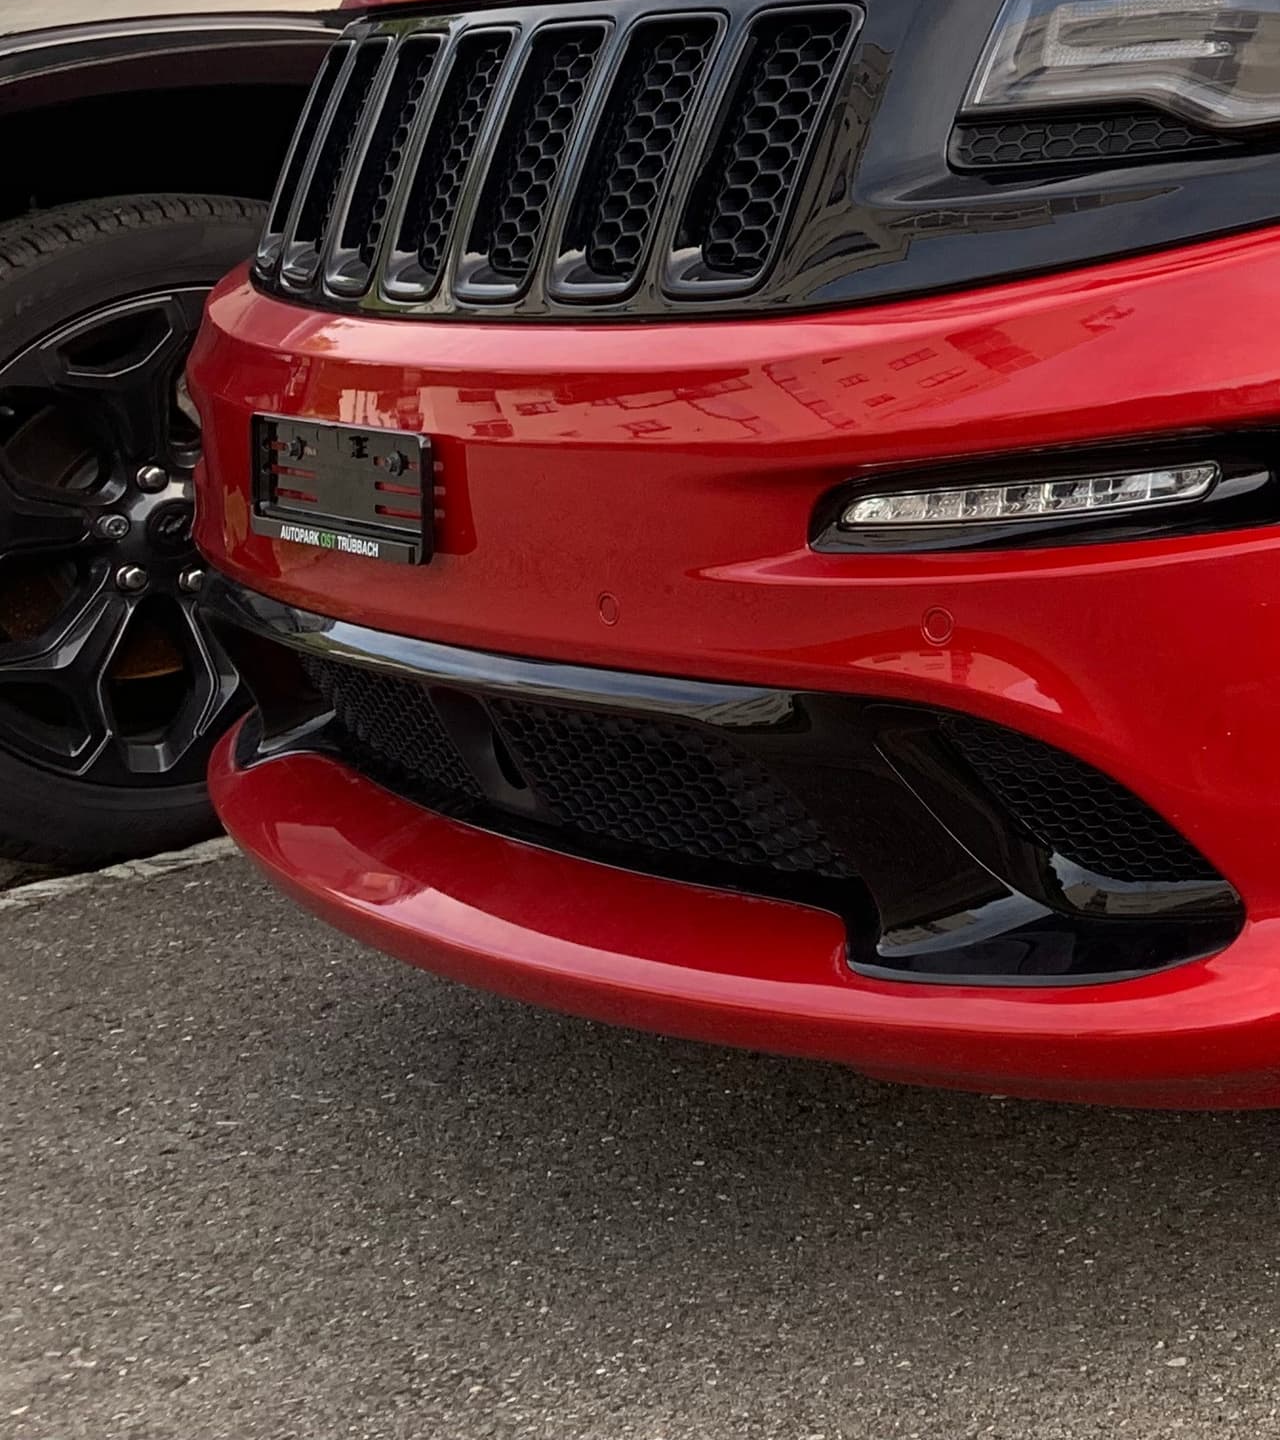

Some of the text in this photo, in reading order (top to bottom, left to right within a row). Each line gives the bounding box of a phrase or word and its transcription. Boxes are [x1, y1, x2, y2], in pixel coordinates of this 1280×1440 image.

[281, 525, 379, 557] AUTOPARK OST TRÜBBACH
